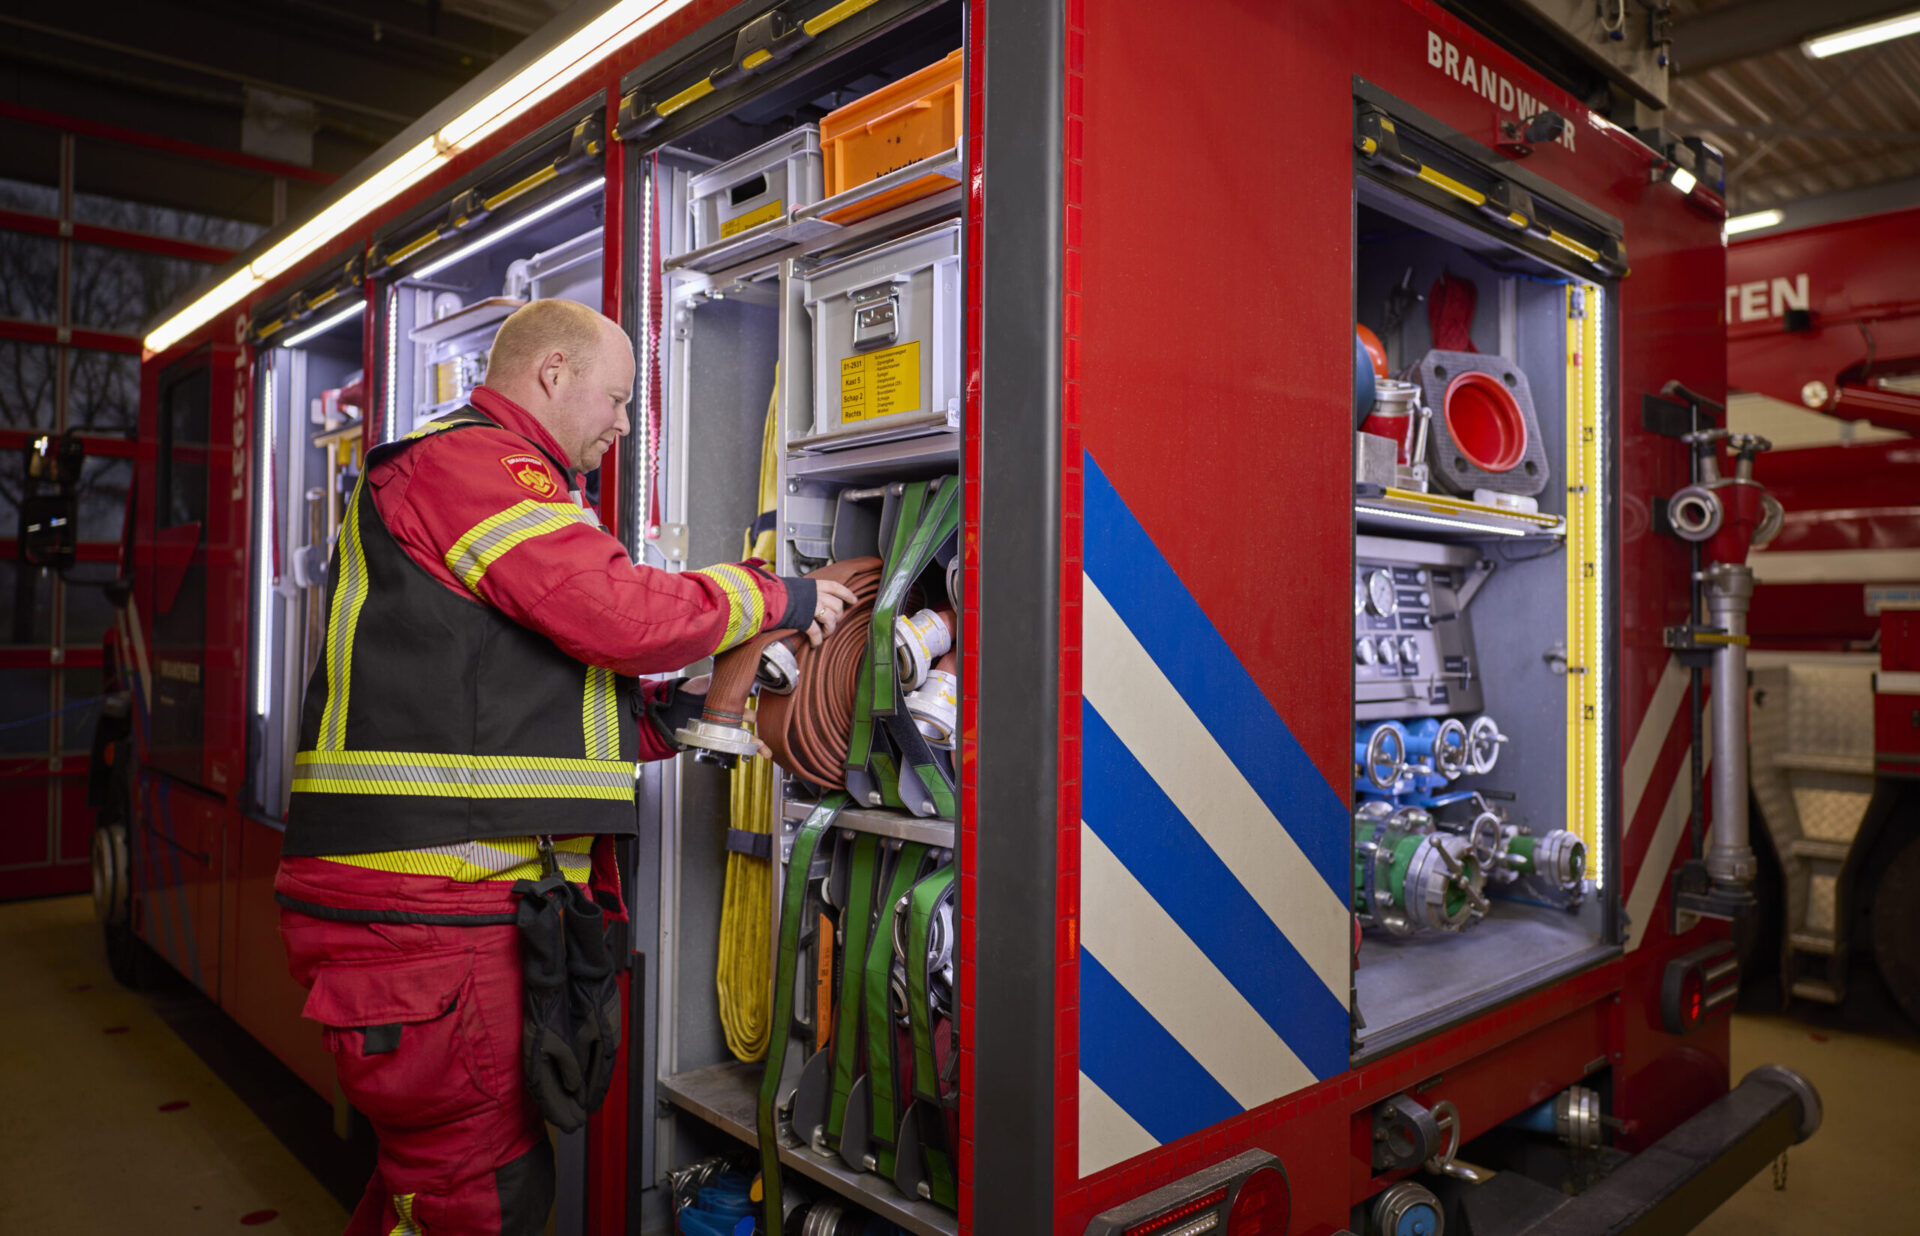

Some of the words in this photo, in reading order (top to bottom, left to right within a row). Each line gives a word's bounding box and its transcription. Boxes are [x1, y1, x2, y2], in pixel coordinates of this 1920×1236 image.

[1427, 29, 1576, 153] BRANDWR
[845, 378, 857, 386] Kast
[843, 394, 859, 403] Schap
[859, 392, 863, 400] 2
[232, 313, 248, 501] 01-2931
[844, 410, 862, 418] Rechts
